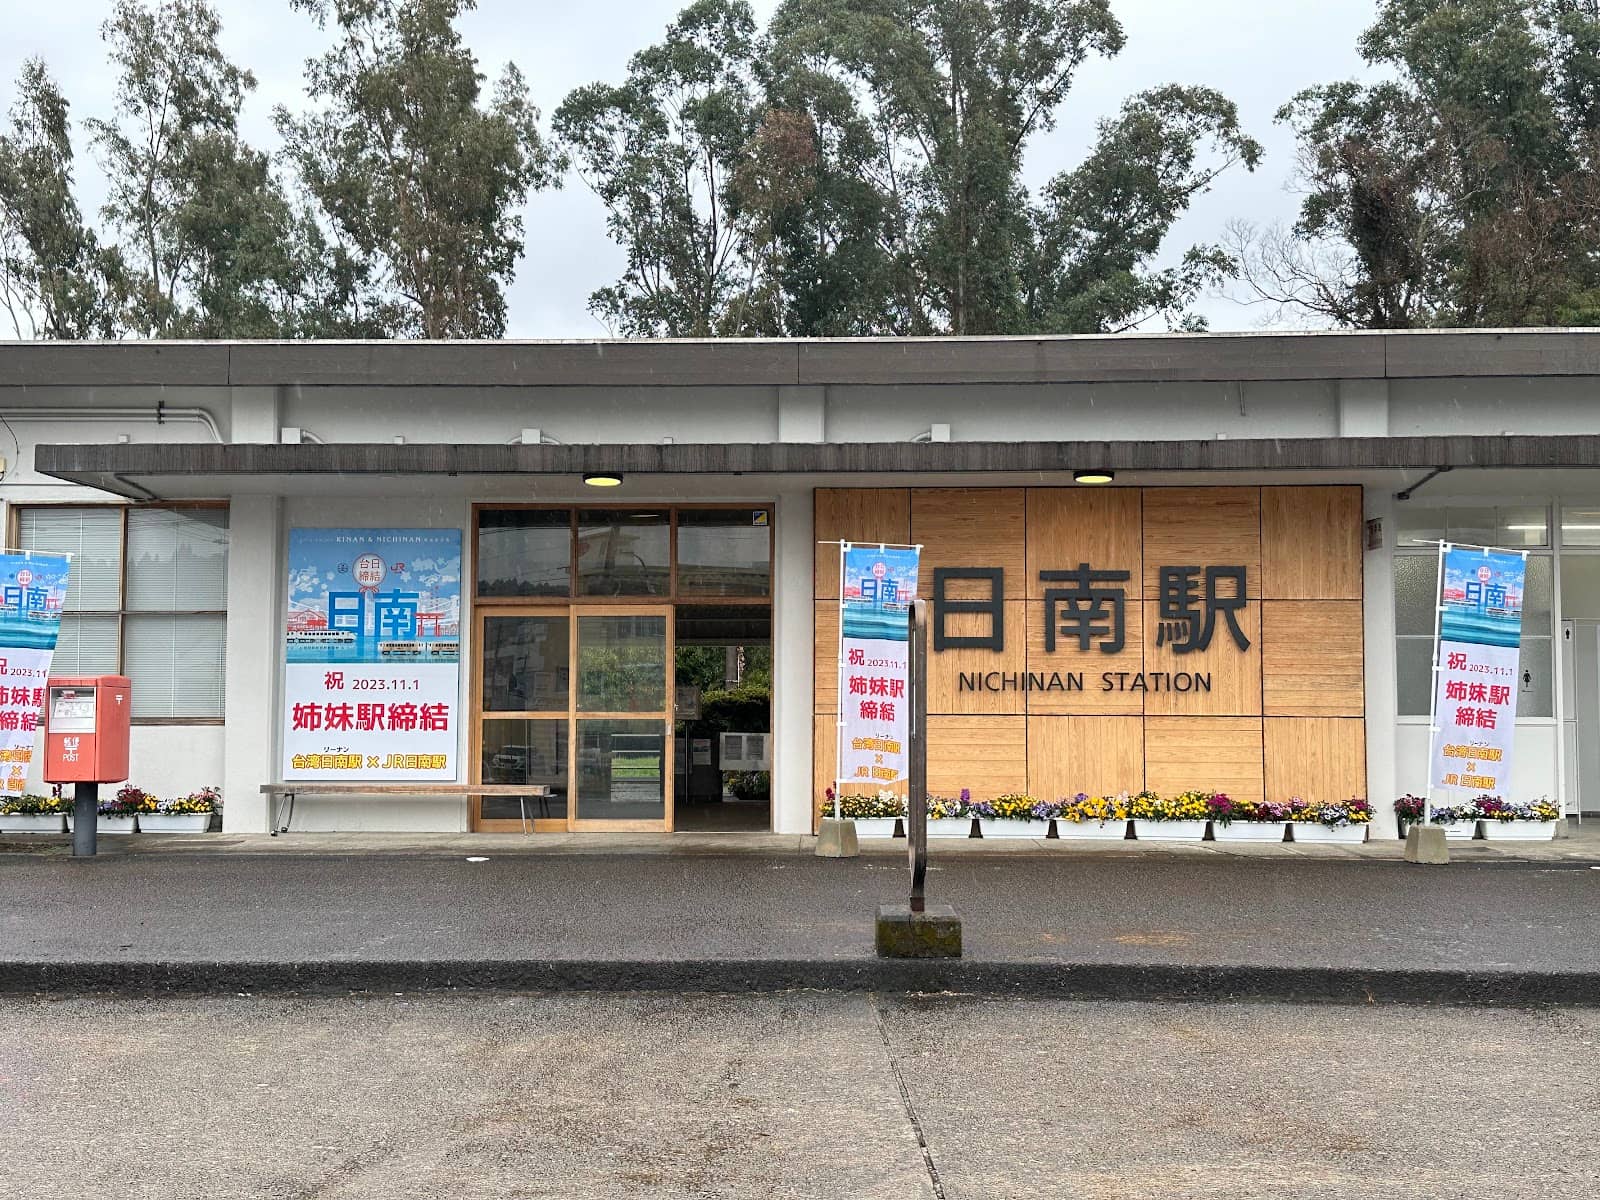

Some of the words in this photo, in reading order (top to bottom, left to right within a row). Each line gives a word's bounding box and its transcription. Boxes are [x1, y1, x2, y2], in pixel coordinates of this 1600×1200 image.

[4, 586, 48, 618] 日南
[861, 578, 899, 602] 日南
[1465, 582, 1507, 608] 日南
[328, 588, 419, 640] 日南
[933, 563, 1250, 654] 日南駅
[848, 648, 865, 666] 祝
[1447, 652, 1467, 671] 祝
[1469, 664, 1514, 676] 2023.11.1
[325, 671, 344, 690] 祝
[352, 679, 420, 690] 2023.11.1
[959, 672, 1083, 691] NICHINAN
[1102, 672, 1212, 692] STATION
[1446, 680, 1511, 706] 姉妹駅
[292, 702, 449, 732] 姉妹駅締結
[859, 700, 895, 722] 締結
[1455, 706, 1498, 730] 締結
[62, 753, 79, 762] POST
[292, 754, 363, 769] 台湾日南駅
[382, 754, 446, 769] JR日南駅
